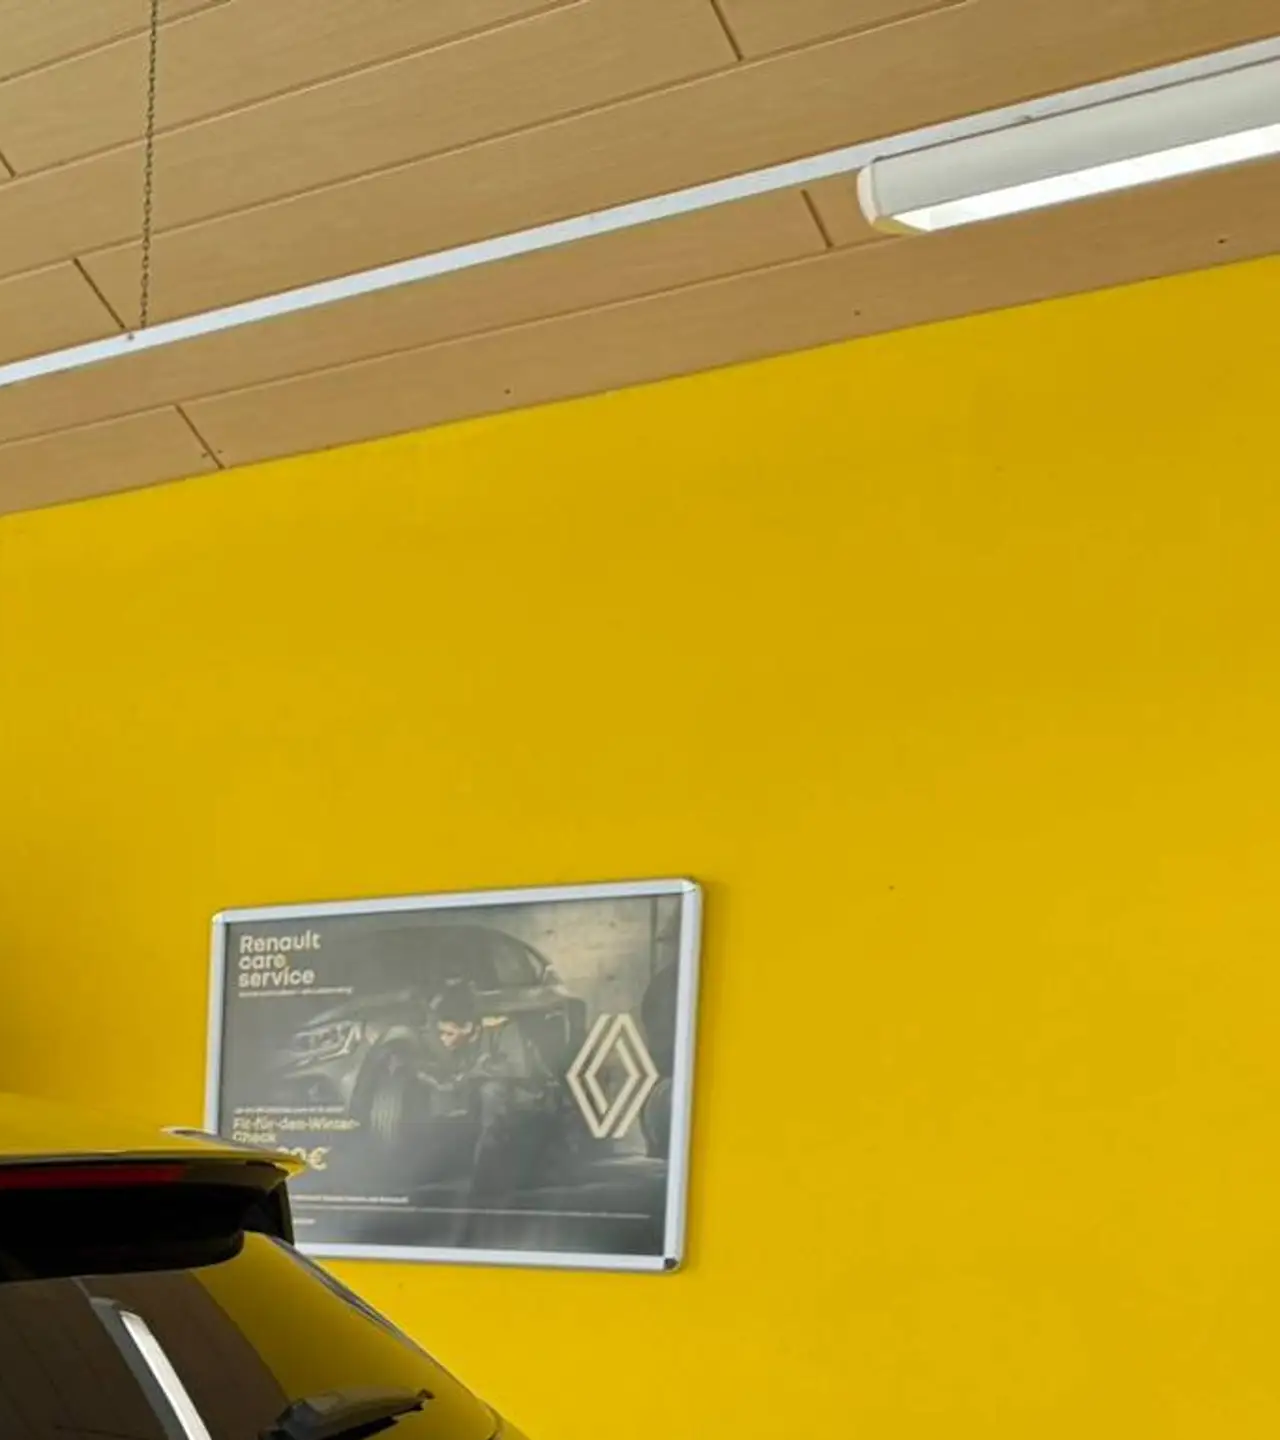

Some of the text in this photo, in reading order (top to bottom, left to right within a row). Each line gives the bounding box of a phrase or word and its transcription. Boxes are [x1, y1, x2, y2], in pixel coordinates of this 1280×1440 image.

[240, 930, 321, 954] Renault
[238, 953, 287, 970] care
[238, 967, 316, 988] service
